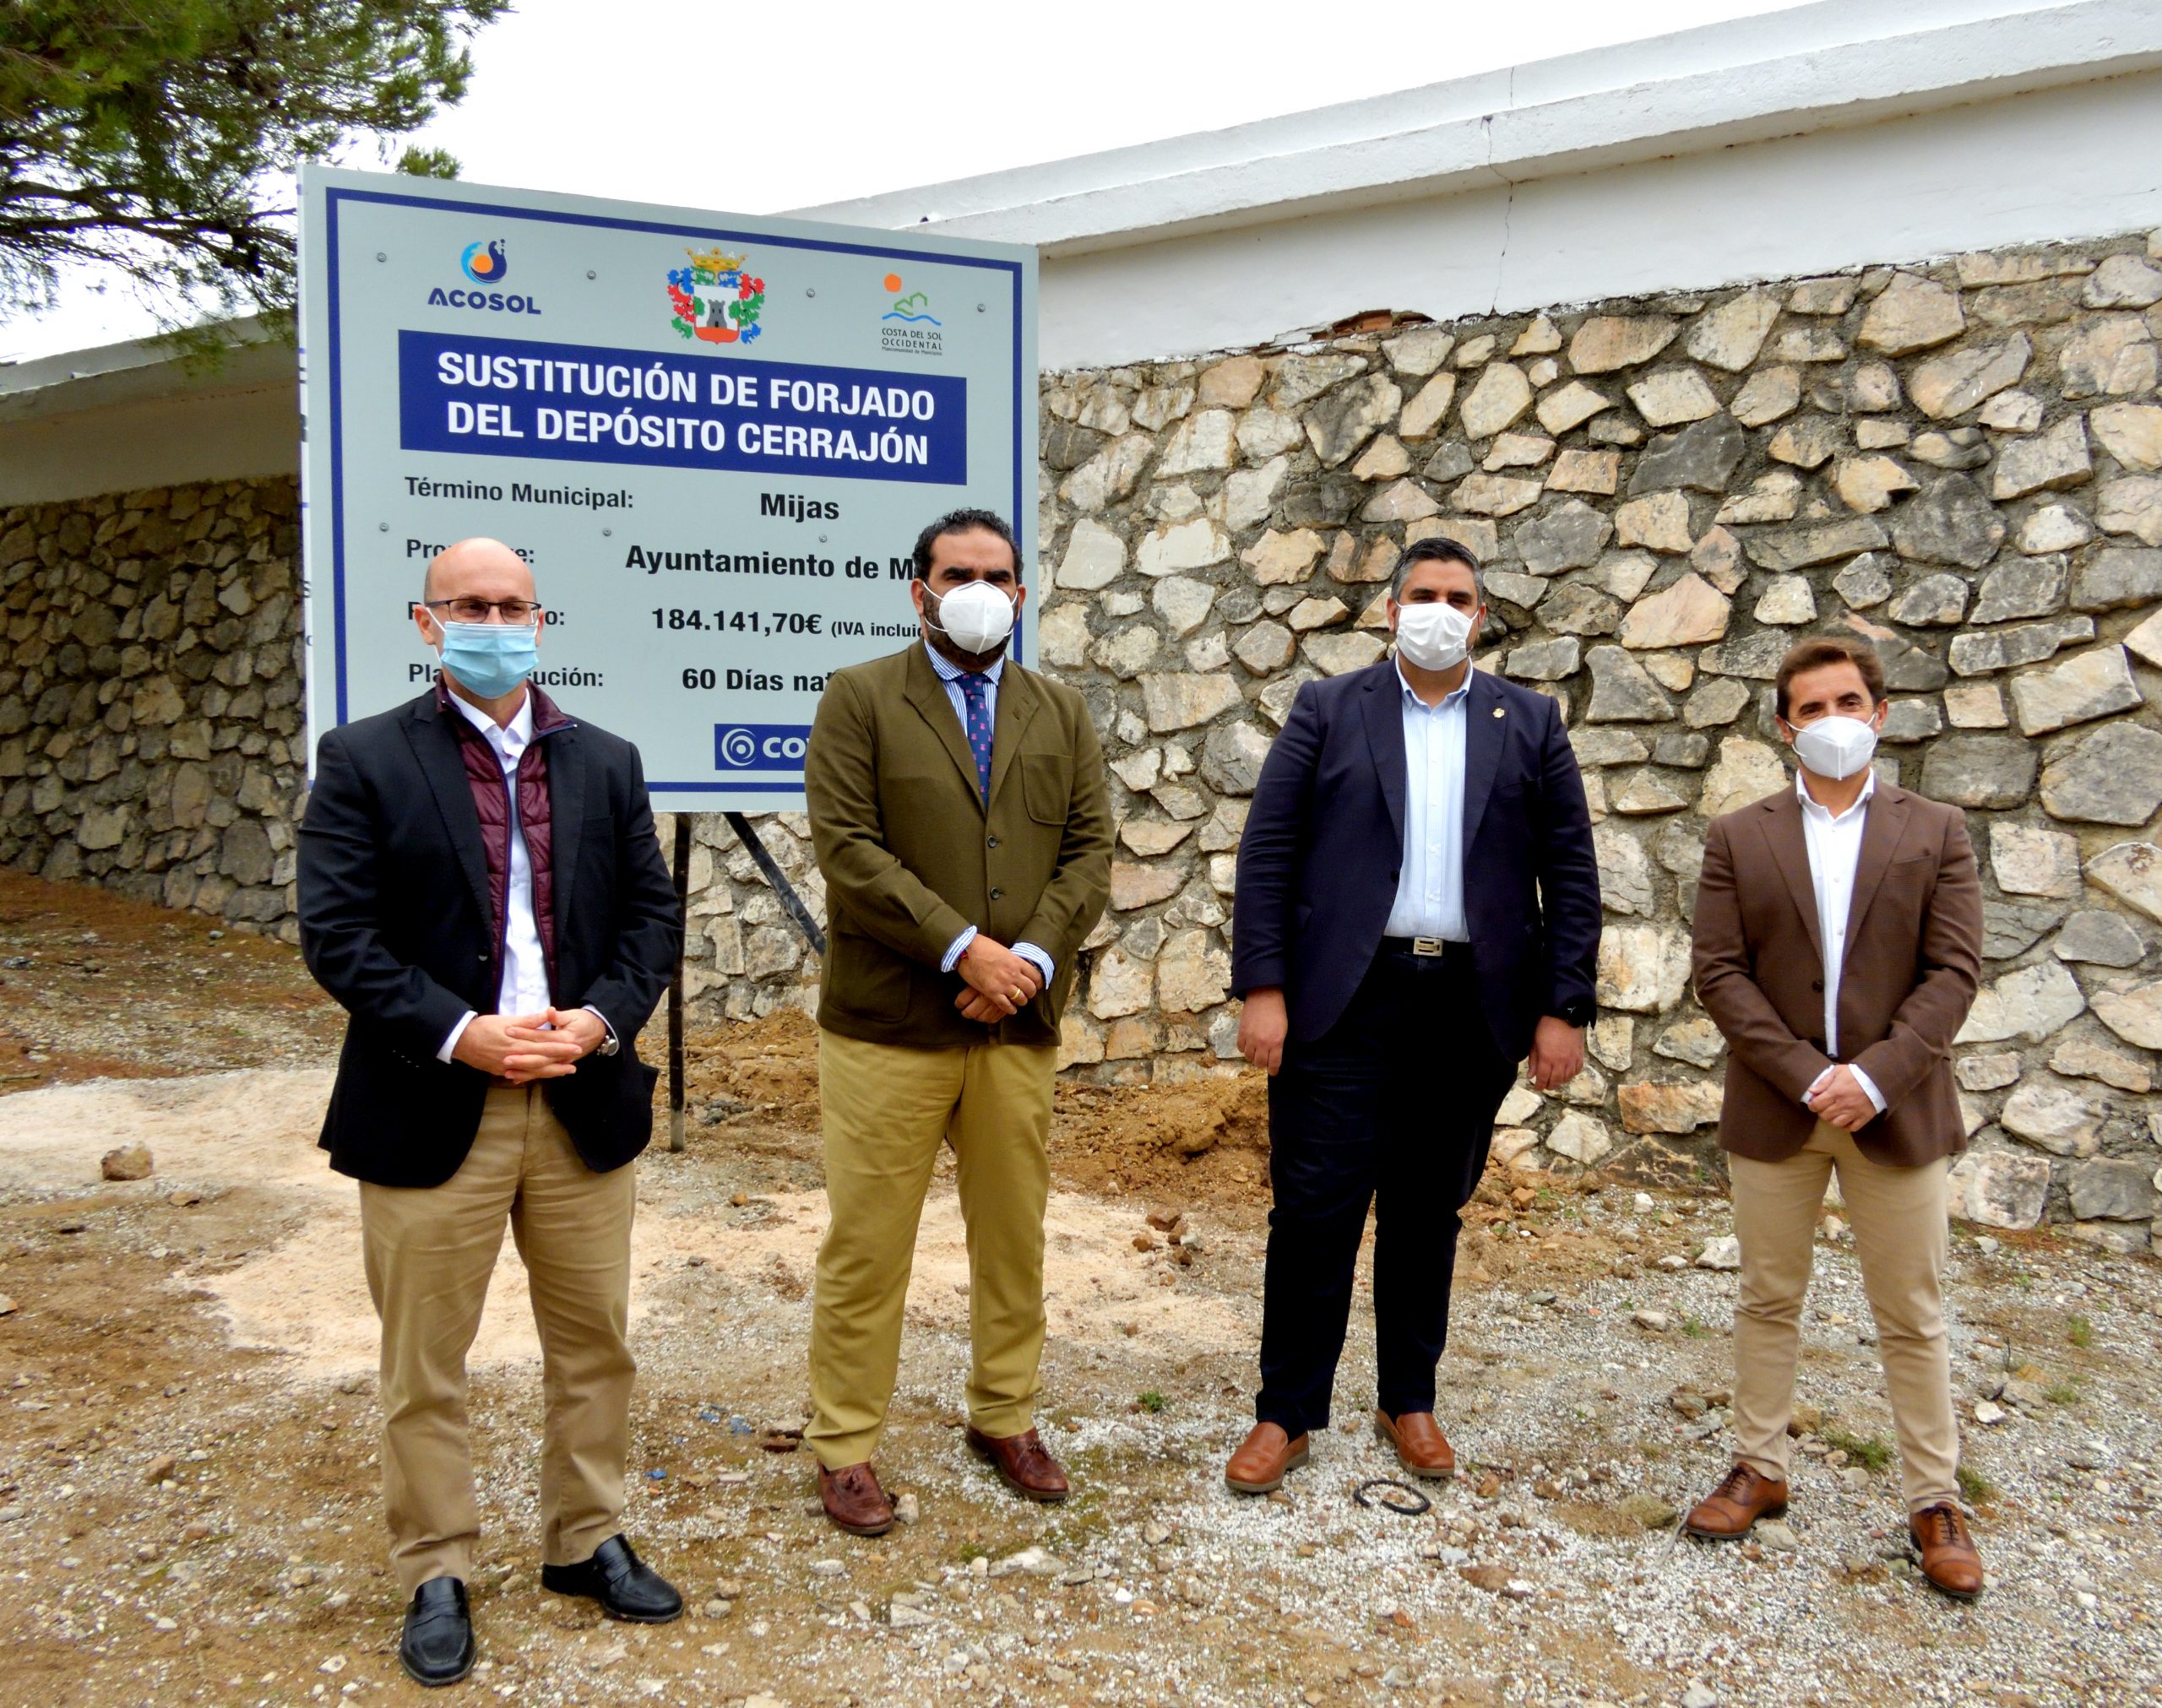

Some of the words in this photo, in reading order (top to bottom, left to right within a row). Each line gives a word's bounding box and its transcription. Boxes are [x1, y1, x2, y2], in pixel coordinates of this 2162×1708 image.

[427, 287, 541, 315] ACOSOL
[882, 328, 908, 337] COSTA
[910, 330, 923, 339] DEL
[927, 332, 942, 340] SOL
[882, 338, 942, 350] OCCIDENTAL
[437, 351, 697, 404] SUSTITUCIÓN
[710, 373, 758, 407] DE
[769, 378, 935, 420] FORJADO
[448, 401, 524, 438] DEL
[536, 406, 725, 452] DEPÓSITO
[737, 422, 928, 465] CERRAJÓN
[405, 476, 503, 502] Término
[511, 483, 633, 511] Municipal:
[760, 492, 839, 523] Mijas
[625, 545, 835, 577] Ayuntamiento
[845, 556, 879, 579] de
[651, 607, 823, 637] 184.141,70€
[830, 621, 865, 638] (IVA
[871, 622, 922, 637] inclui
[528, 667, 603, 687] ución:
[682, 668, 717, 690] 60
[725, 668, 784, 691] Días
